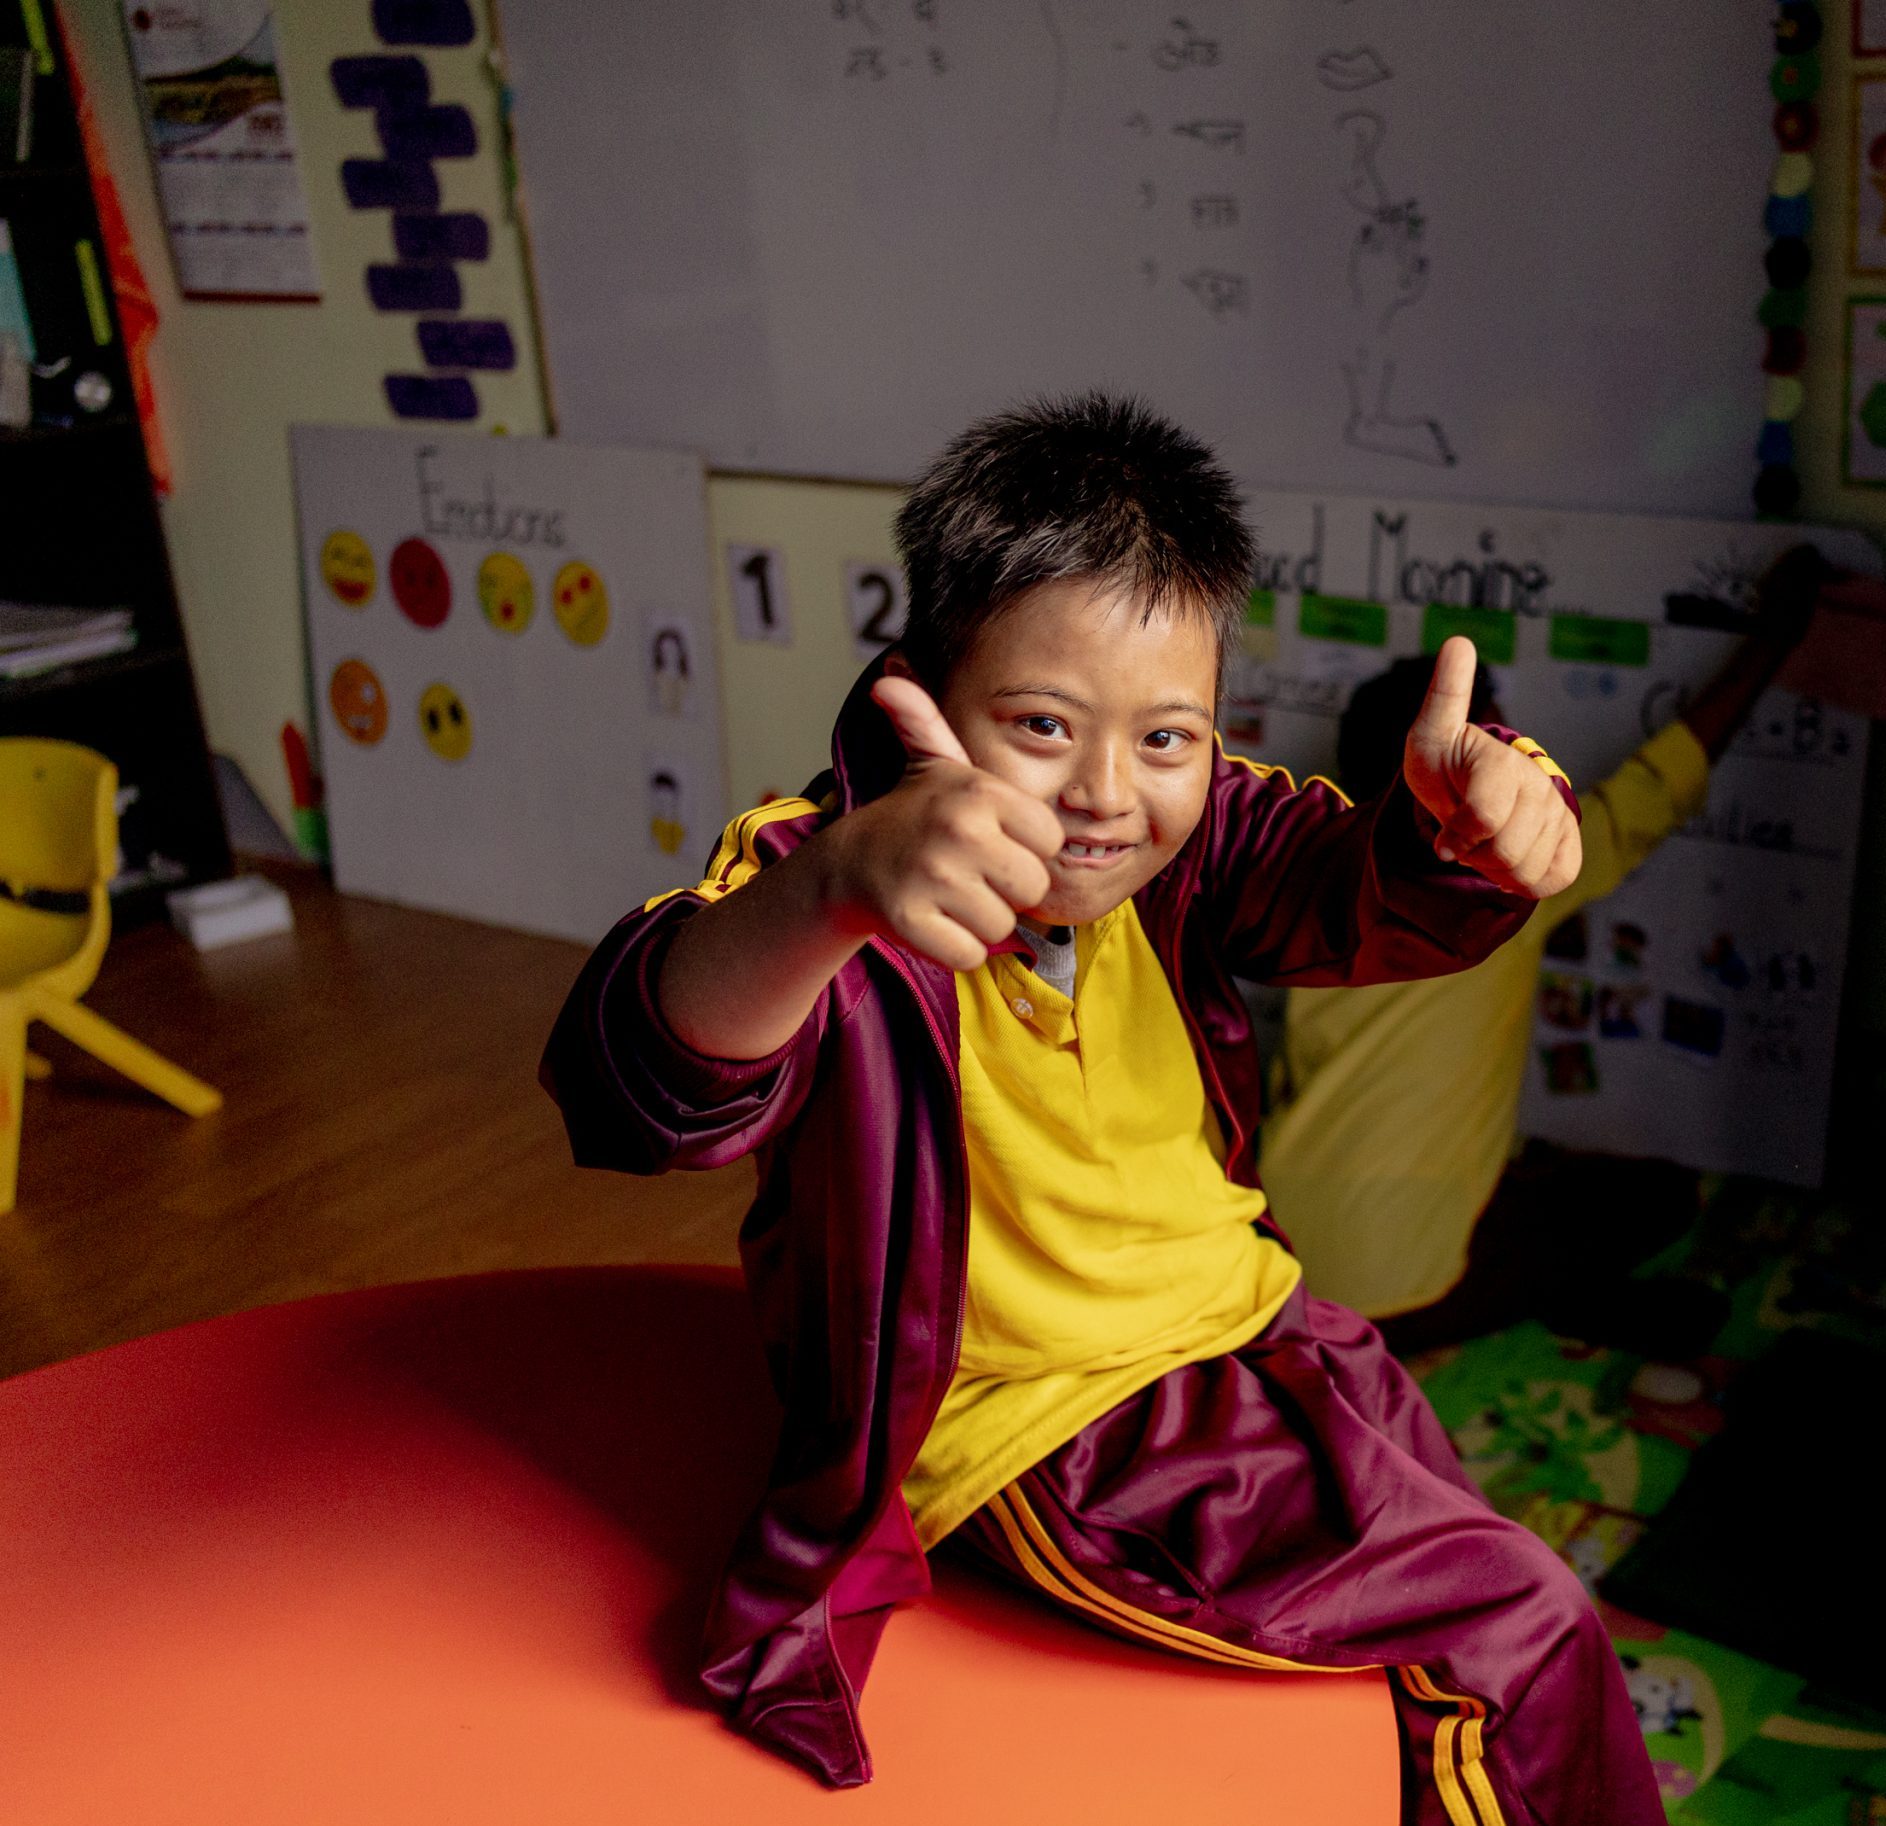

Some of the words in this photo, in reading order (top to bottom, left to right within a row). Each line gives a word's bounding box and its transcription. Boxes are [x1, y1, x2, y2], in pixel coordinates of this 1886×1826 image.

[1252, 502, 1325, 598] ood
[742, 552, 773, 627] 1
[857, 571, 897, 643] 2
